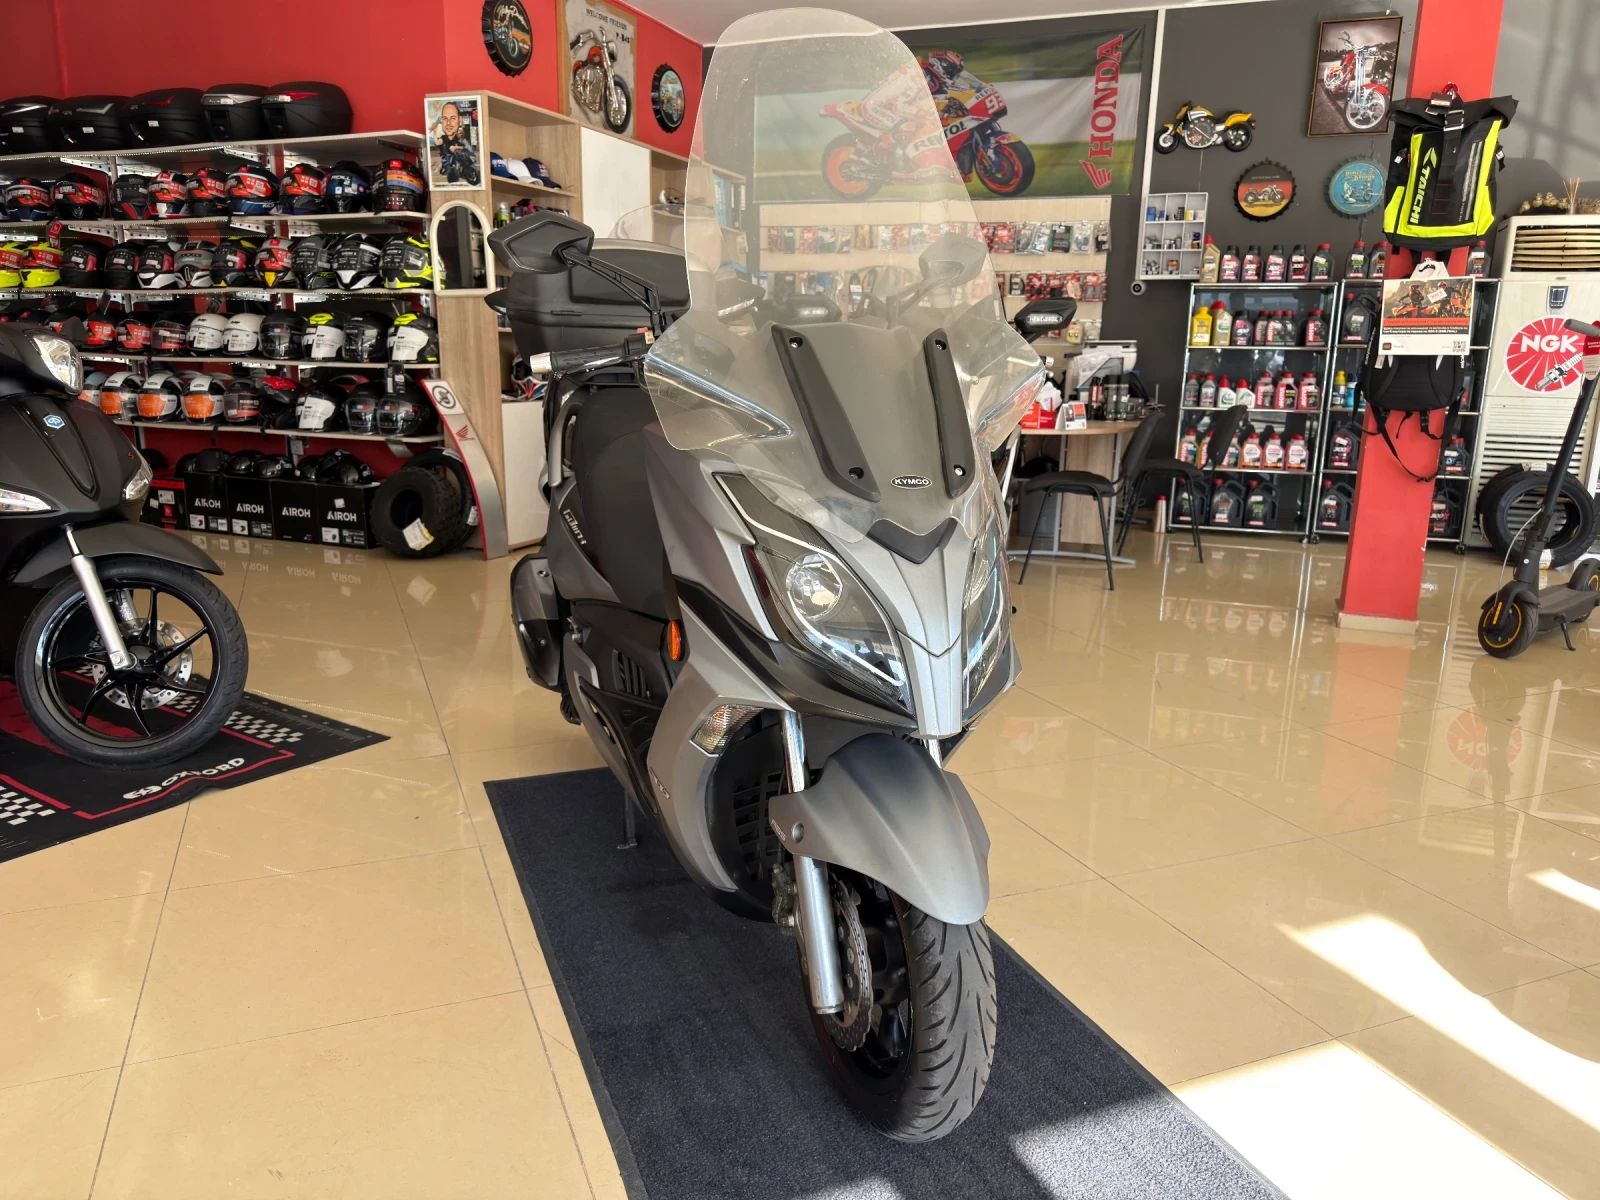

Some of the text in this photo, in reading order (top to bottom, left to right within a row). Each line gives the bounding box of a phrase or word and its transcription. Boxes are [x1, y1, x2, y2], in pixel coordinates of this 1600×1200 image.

[1088, 34, 1123, 159] HONDA
[1410, 165, 1431, 224] TAICHI
[1520, 334, 1580, 353] NGK
[194, 497, 221, 509] AIROH
[236, 503, 264, 514] AIROH
[281, 507, 311, 518] AIROH
[327, 510, 357, 522] AIROH
